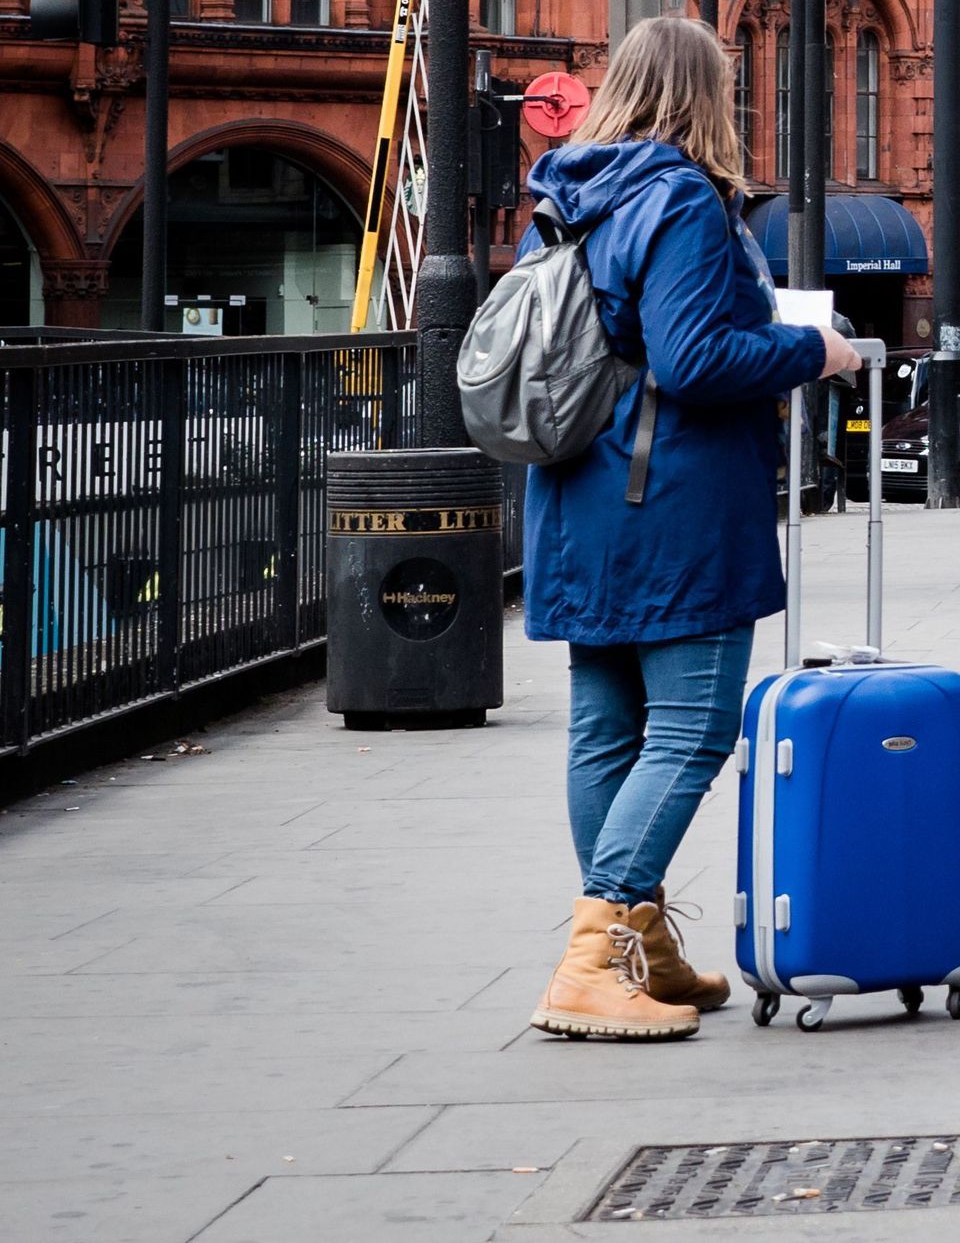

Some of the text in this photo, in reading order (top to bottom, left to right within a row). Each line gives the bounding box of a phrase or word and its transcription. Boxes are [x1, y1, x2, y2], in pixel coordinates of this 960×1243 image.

[846, 260, 901, 272] Imperial Hall
[328, 510, 501, 531] LITTER LITTE
[397, 592, 456, 605] Hackney
